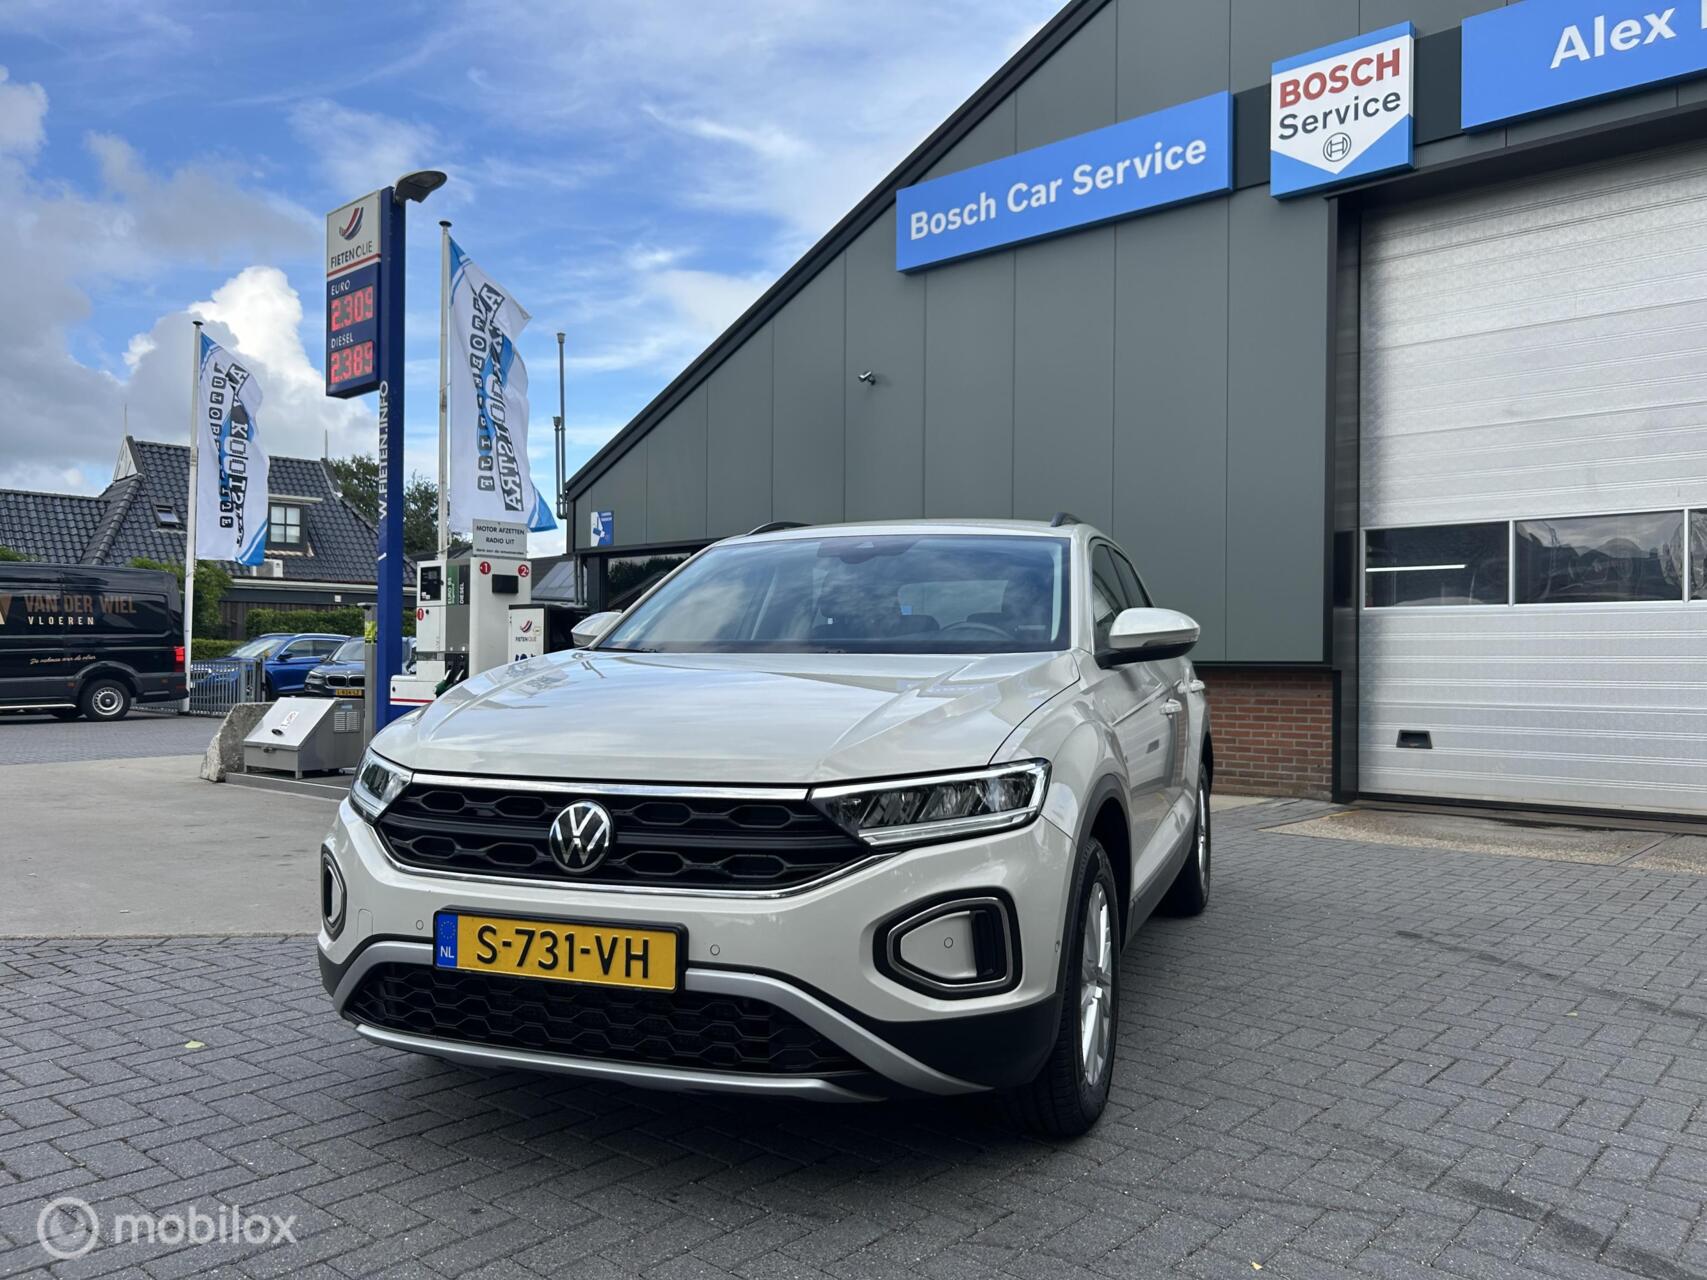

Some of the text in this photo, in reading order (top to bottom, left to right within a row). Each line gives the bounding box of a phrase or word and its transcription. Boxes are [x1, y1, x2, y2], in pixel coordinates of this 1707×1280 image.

[1550, 8, 1677, 69] Alex
[1280, 48, 1400, 109] BOSCH
[1278, 92, 1401, 141] Service
[911, 139, 1207, 240] Bosch Car Service
[331, 280, 351, 296] EURO
[331, 332, 354, 348] DIESEL
[24, 594, 137, 613] VAN DER WIEL
[28, 616, 95, 625] VLOEREN
[440, 945, 455, 959] NL
[476, 924, 650, 979] S-731-VH
